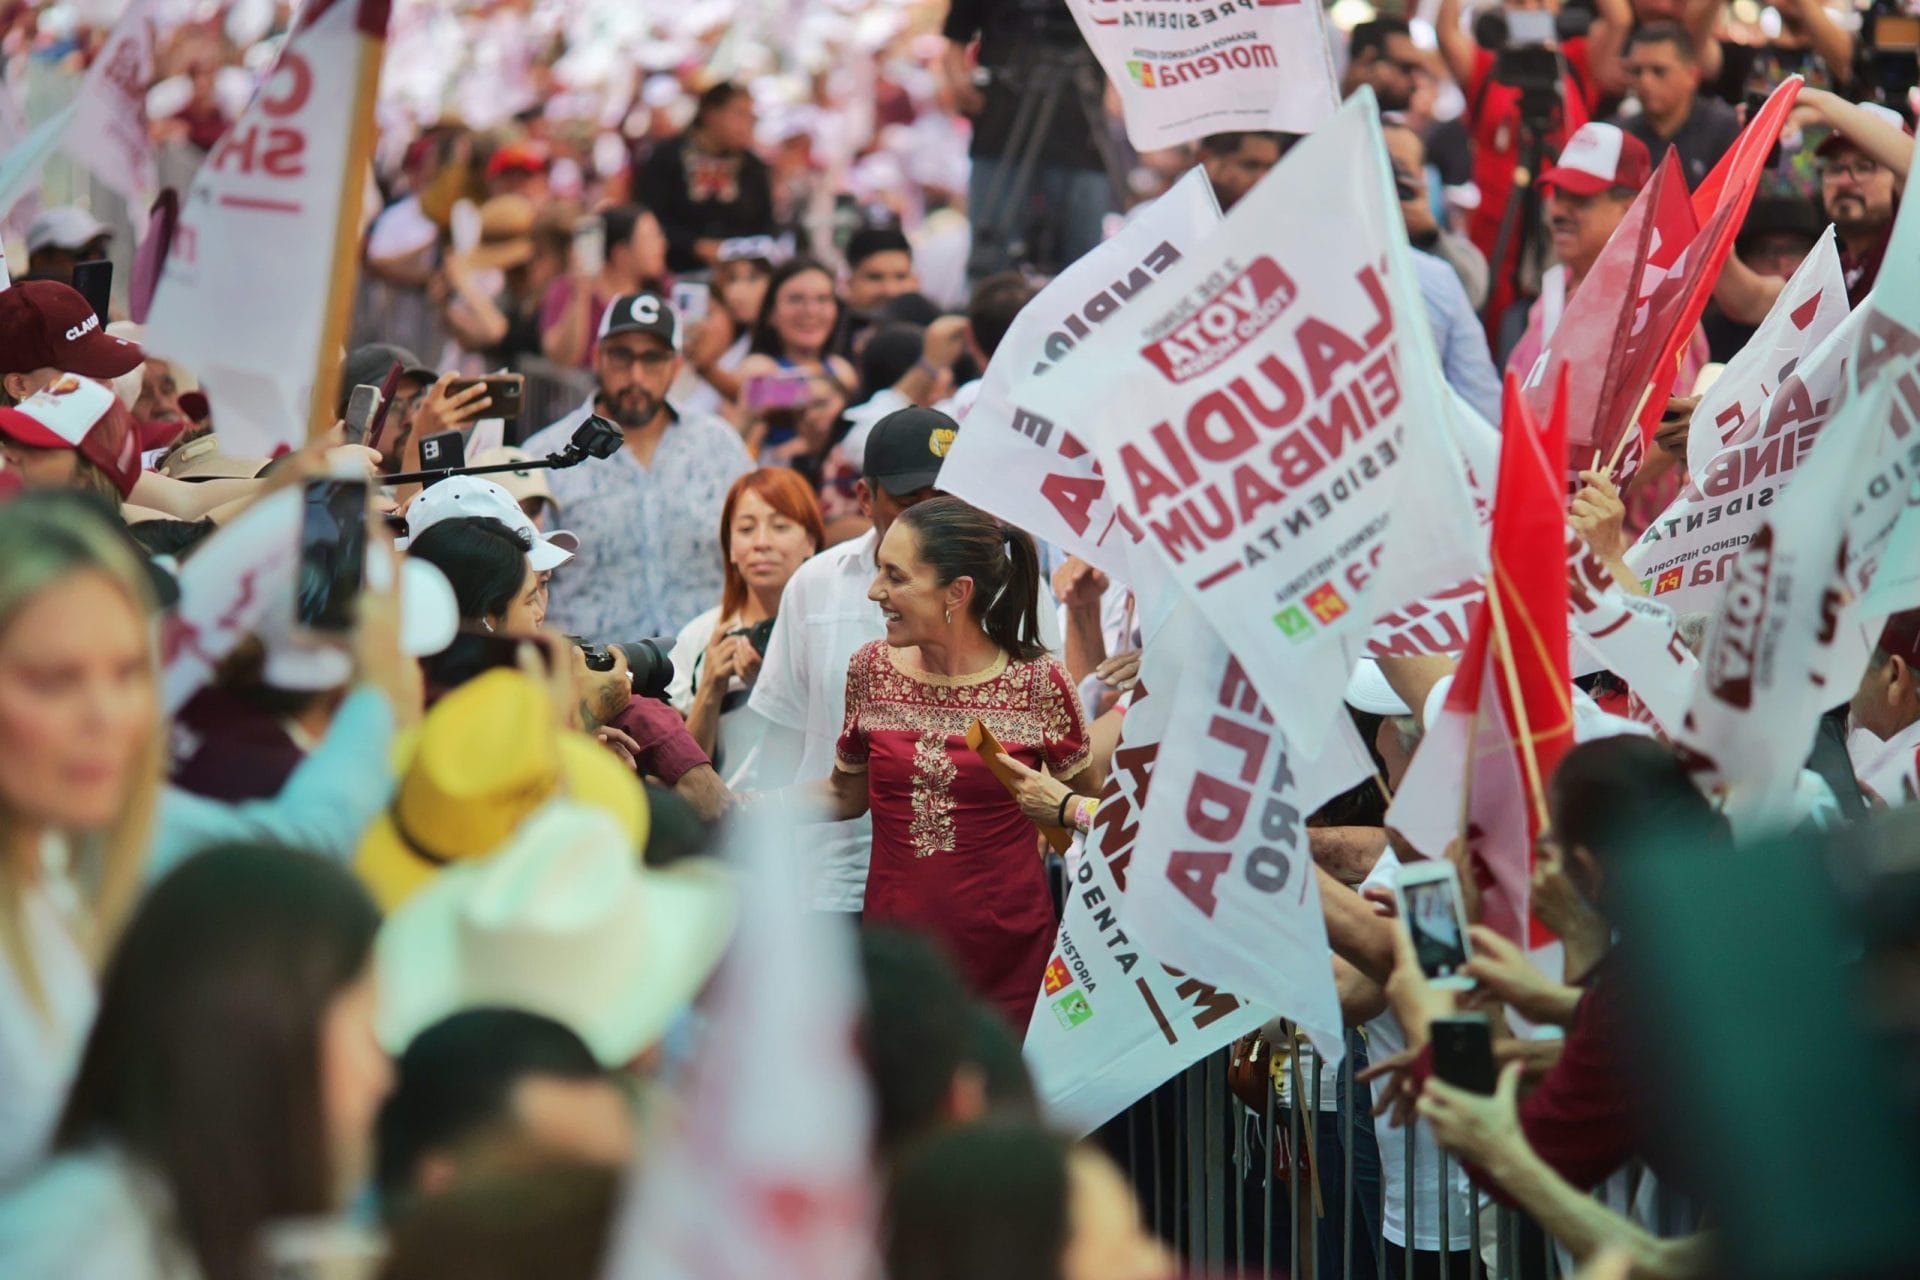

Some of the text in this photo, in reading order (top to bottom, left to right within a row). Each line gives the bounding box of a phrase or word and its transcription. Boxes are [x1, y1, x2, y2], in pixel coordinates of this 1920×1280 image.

[630, 295, 660, 324] C
[1078, 860, 1139, 975] DENTA
[1060, 931, 1097, 994] HISTORIA
